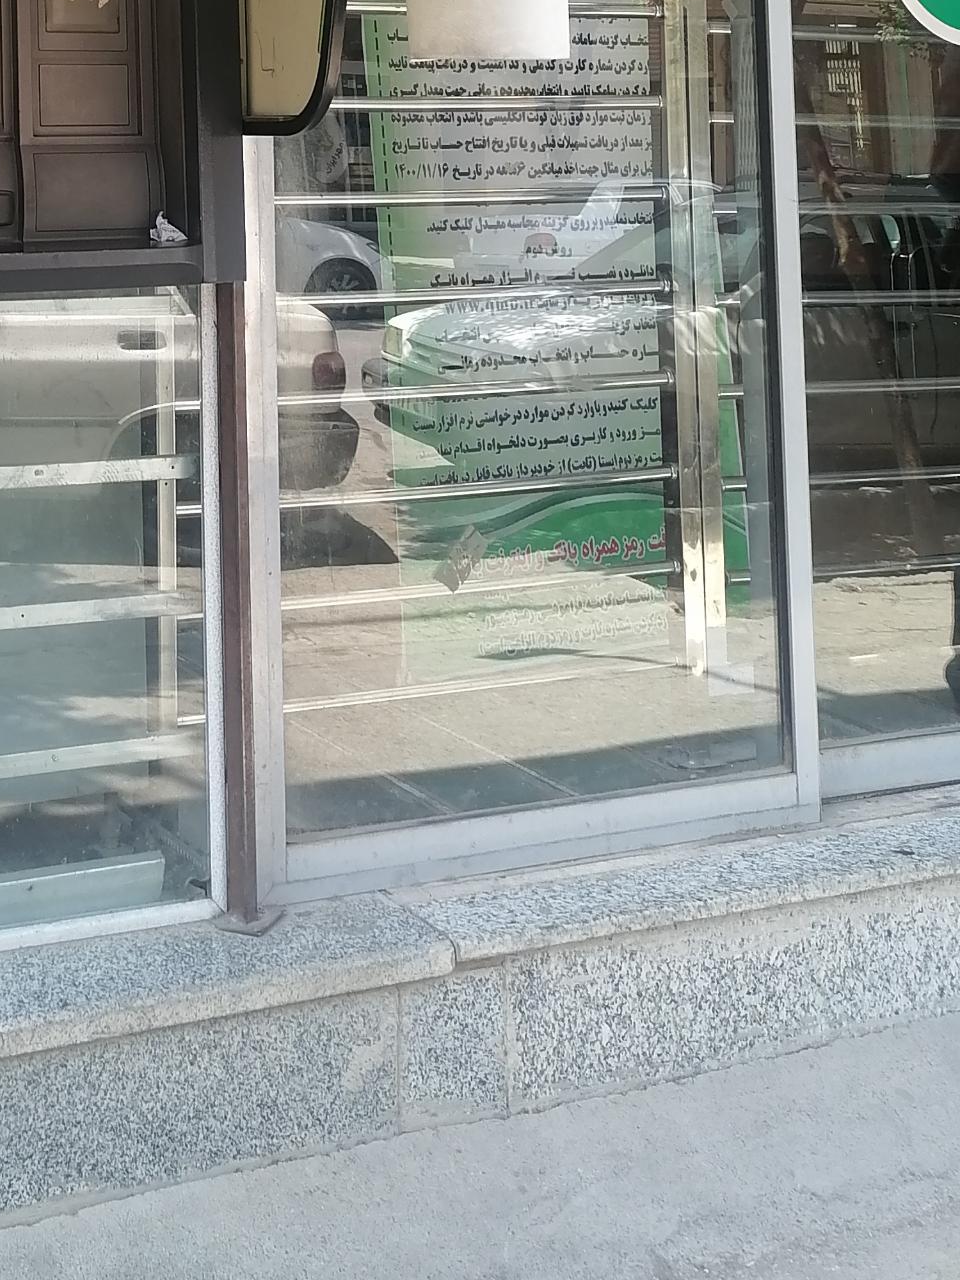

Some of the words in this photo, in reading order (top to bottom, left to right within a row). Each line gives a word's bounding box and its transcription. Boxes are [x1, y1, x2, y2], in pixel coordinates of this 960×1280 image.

[571, 31, 598, 46] سامانه
[598, 33, 619, 50] گزینه
[392, 137, 422, 154] تاریخ
[421, 137, 429, 150] تا
[430, 137, 464, 153] حساب
[465, 135, 491, 153] افتتاح
[491, 136, 519, 153] تاریخ
[519, 136, 528, 152] یا
[529, 141, 536, 152] و
[537, 135, 556, 153] قبلی
[556, 135, 588, 151] تسهیلات
[588, 135, 619, 152] دریافت
[620, 135, 628, 151] از
[628, 136, 644, 151] بعد
[394, 162, 449, 179] ۱۴۰۰/۱۱/۱۶
[452, 163, 482, 181] تاریخ
[484, 165, 495, 180] در
[527, 162, 563, 179] میانگین
[563, 161, 578, 175] اخذ
[579, 164, 599, 178] جهت
[600, 161, 619, 178] مثال
[621, 160, 640, 178] برای
[629, 211, 654, 229] نتخاب
[633, 317, 657, 331] نتخاب
[638, 426, 661, 440] مز
[547, 540, 578, 566] بانک
[581, 535, 619, 563] همراه
[623, 535, 645, 560] رمز
[535, 549, 545, 571] و
